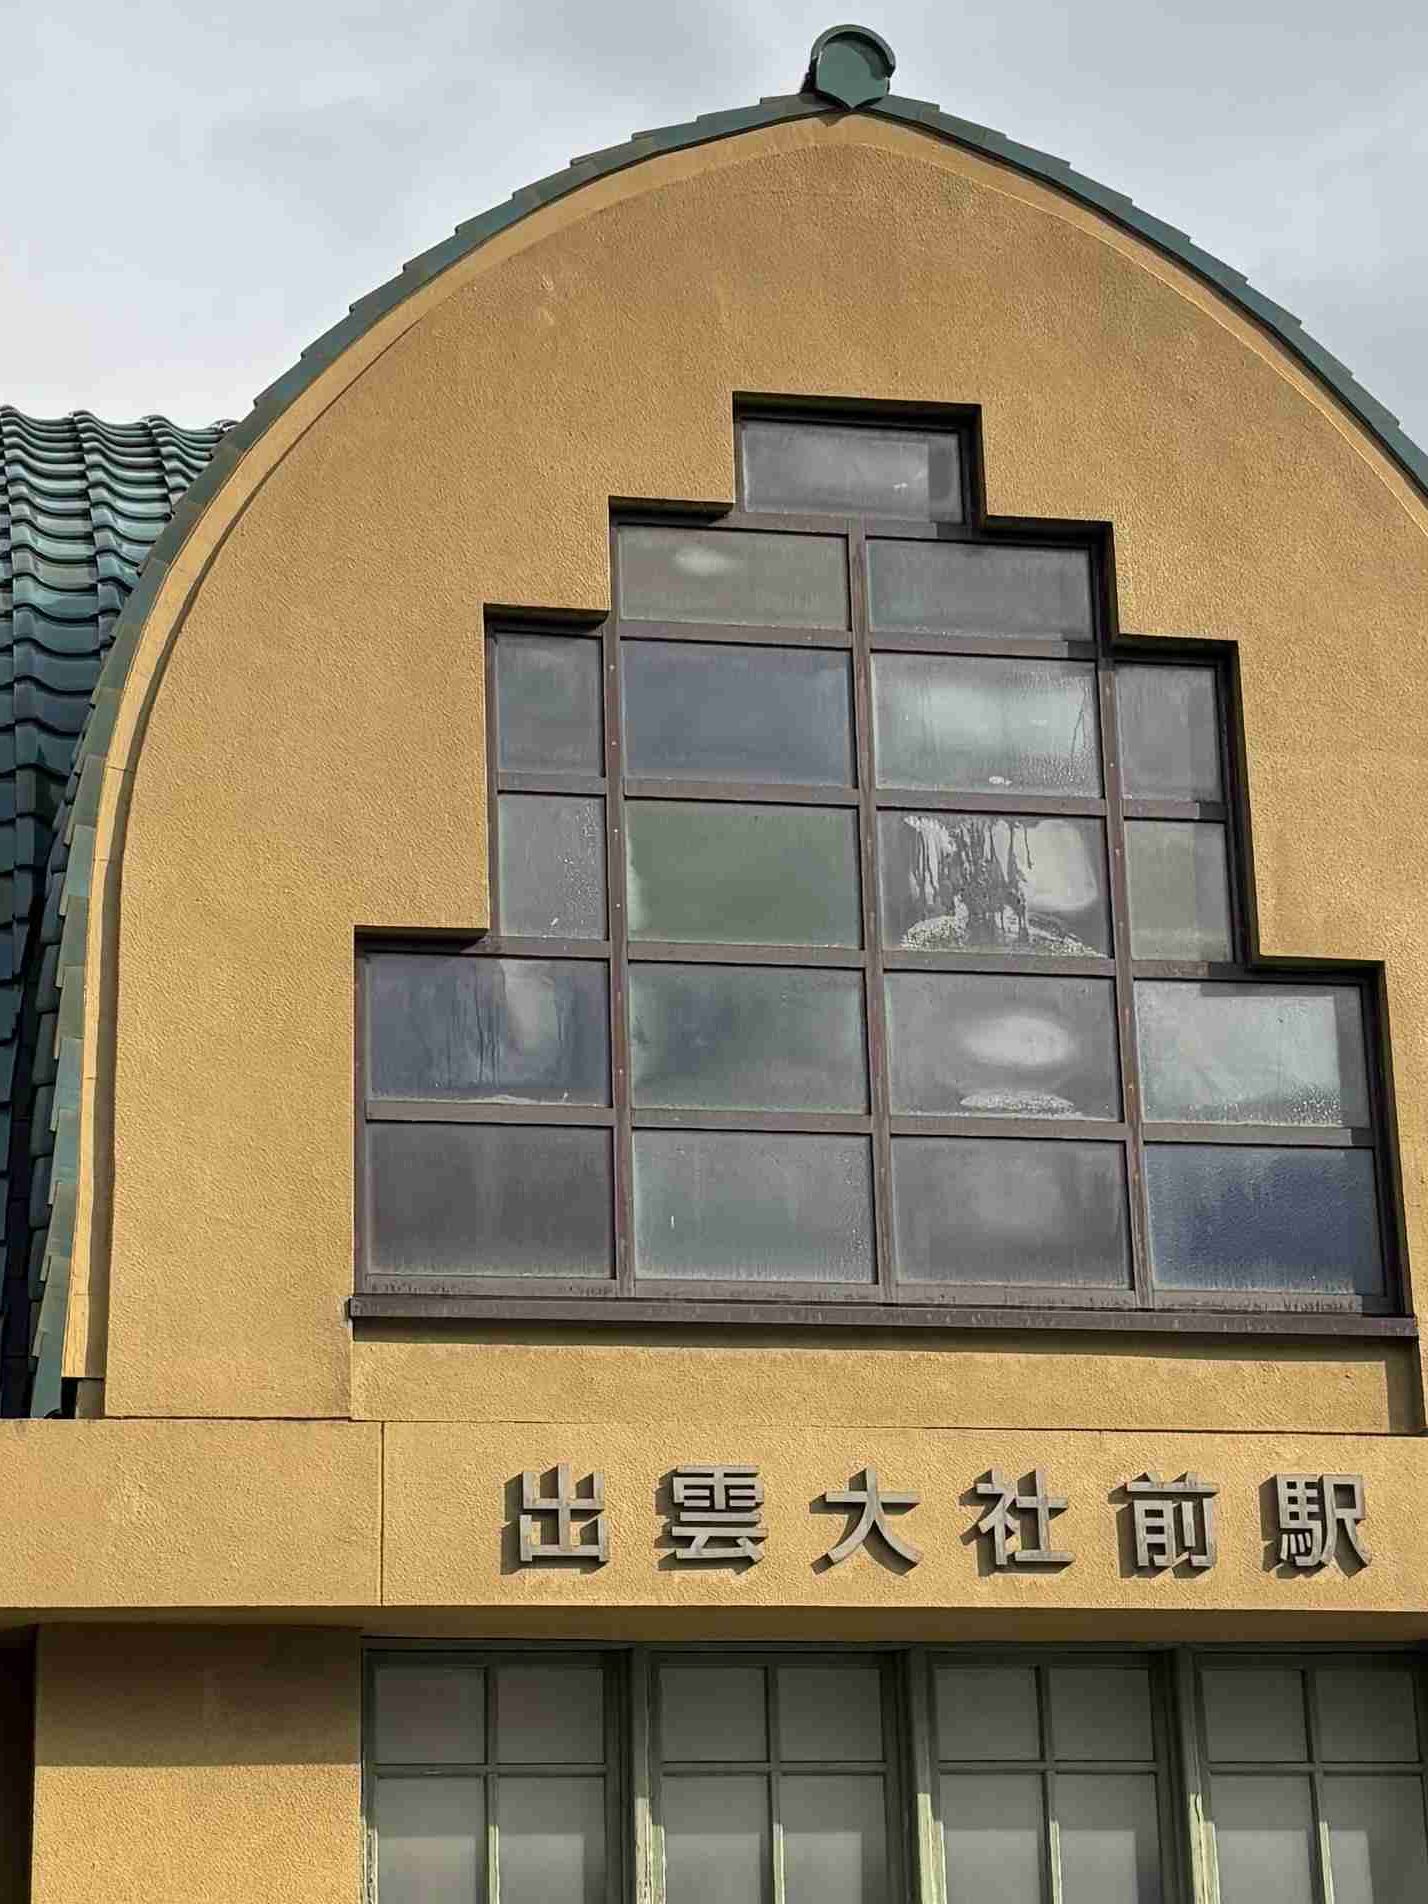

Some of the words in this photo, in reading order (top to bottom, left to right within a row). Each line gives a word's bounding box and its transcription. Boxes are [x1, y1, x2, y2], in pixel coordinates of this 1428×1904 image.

[517, 1462, 1372, 1573] 出雲大社前駅
